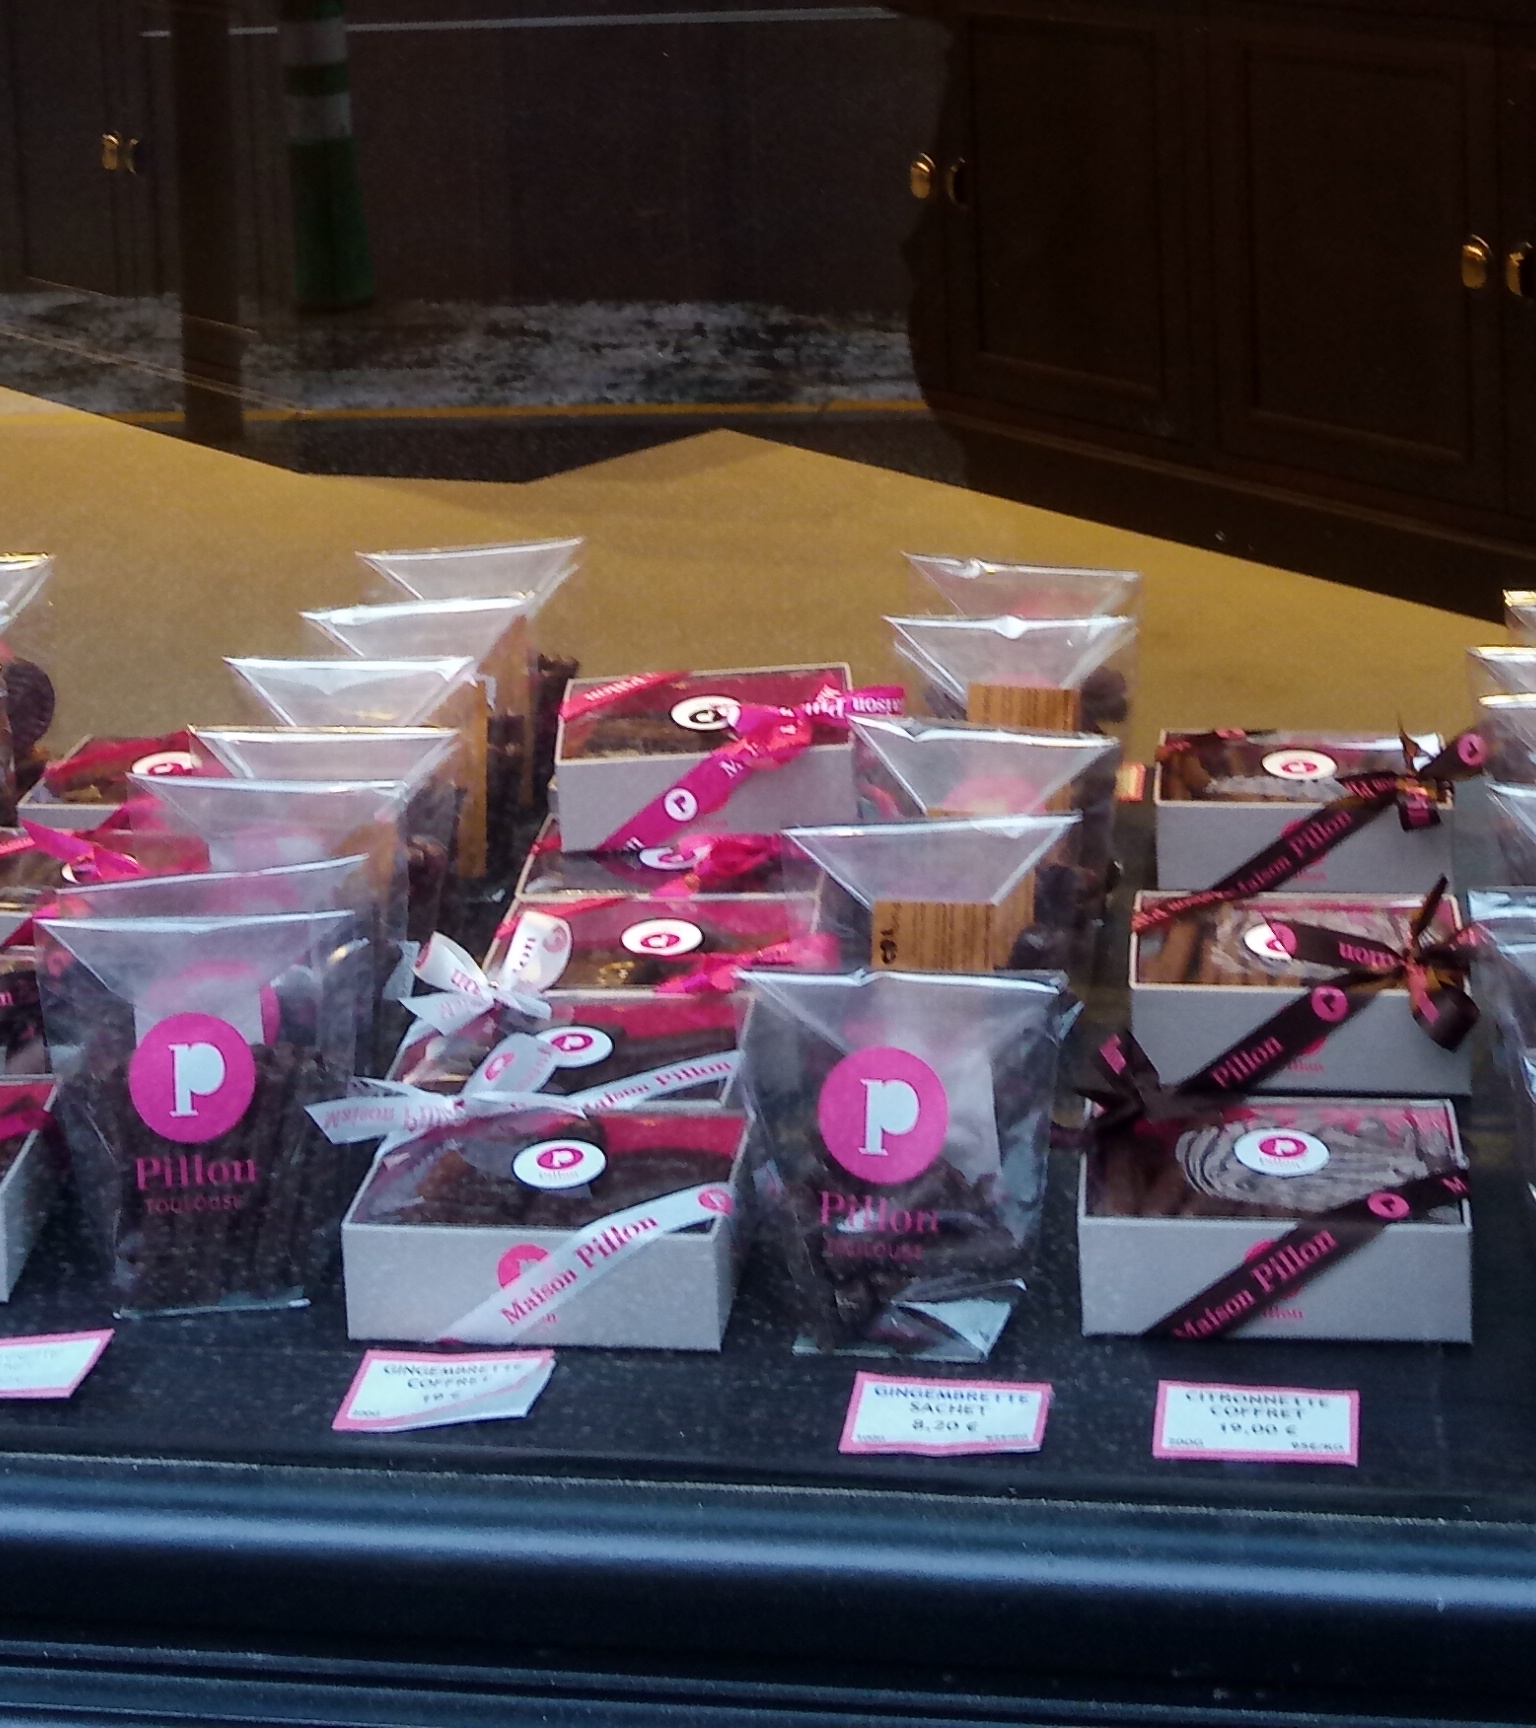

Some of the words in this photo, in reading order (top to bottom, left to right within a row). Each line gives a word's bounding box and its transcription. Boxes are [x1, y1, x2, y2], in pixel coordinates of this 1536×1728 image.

[136, 1153, 258, 1191] Pillon
[819, 1189, 940, 1236] Pillon
[499, 1267, 578, 1326] Maison
[574, 1215, 660, 1272] Pillon
[1172, 1286, 1257, 1339] Maison
[1250, 1228, 1339, 1294] Pillon
[874, 1384, 1030, 1405] GINGEMBRETTE
[909, 1401, 988, 1417] SACHET
[1184, 1390, 1330, 1409] CITRONNETTE
[1209, 1406, 1308, 1421] COFFRET
